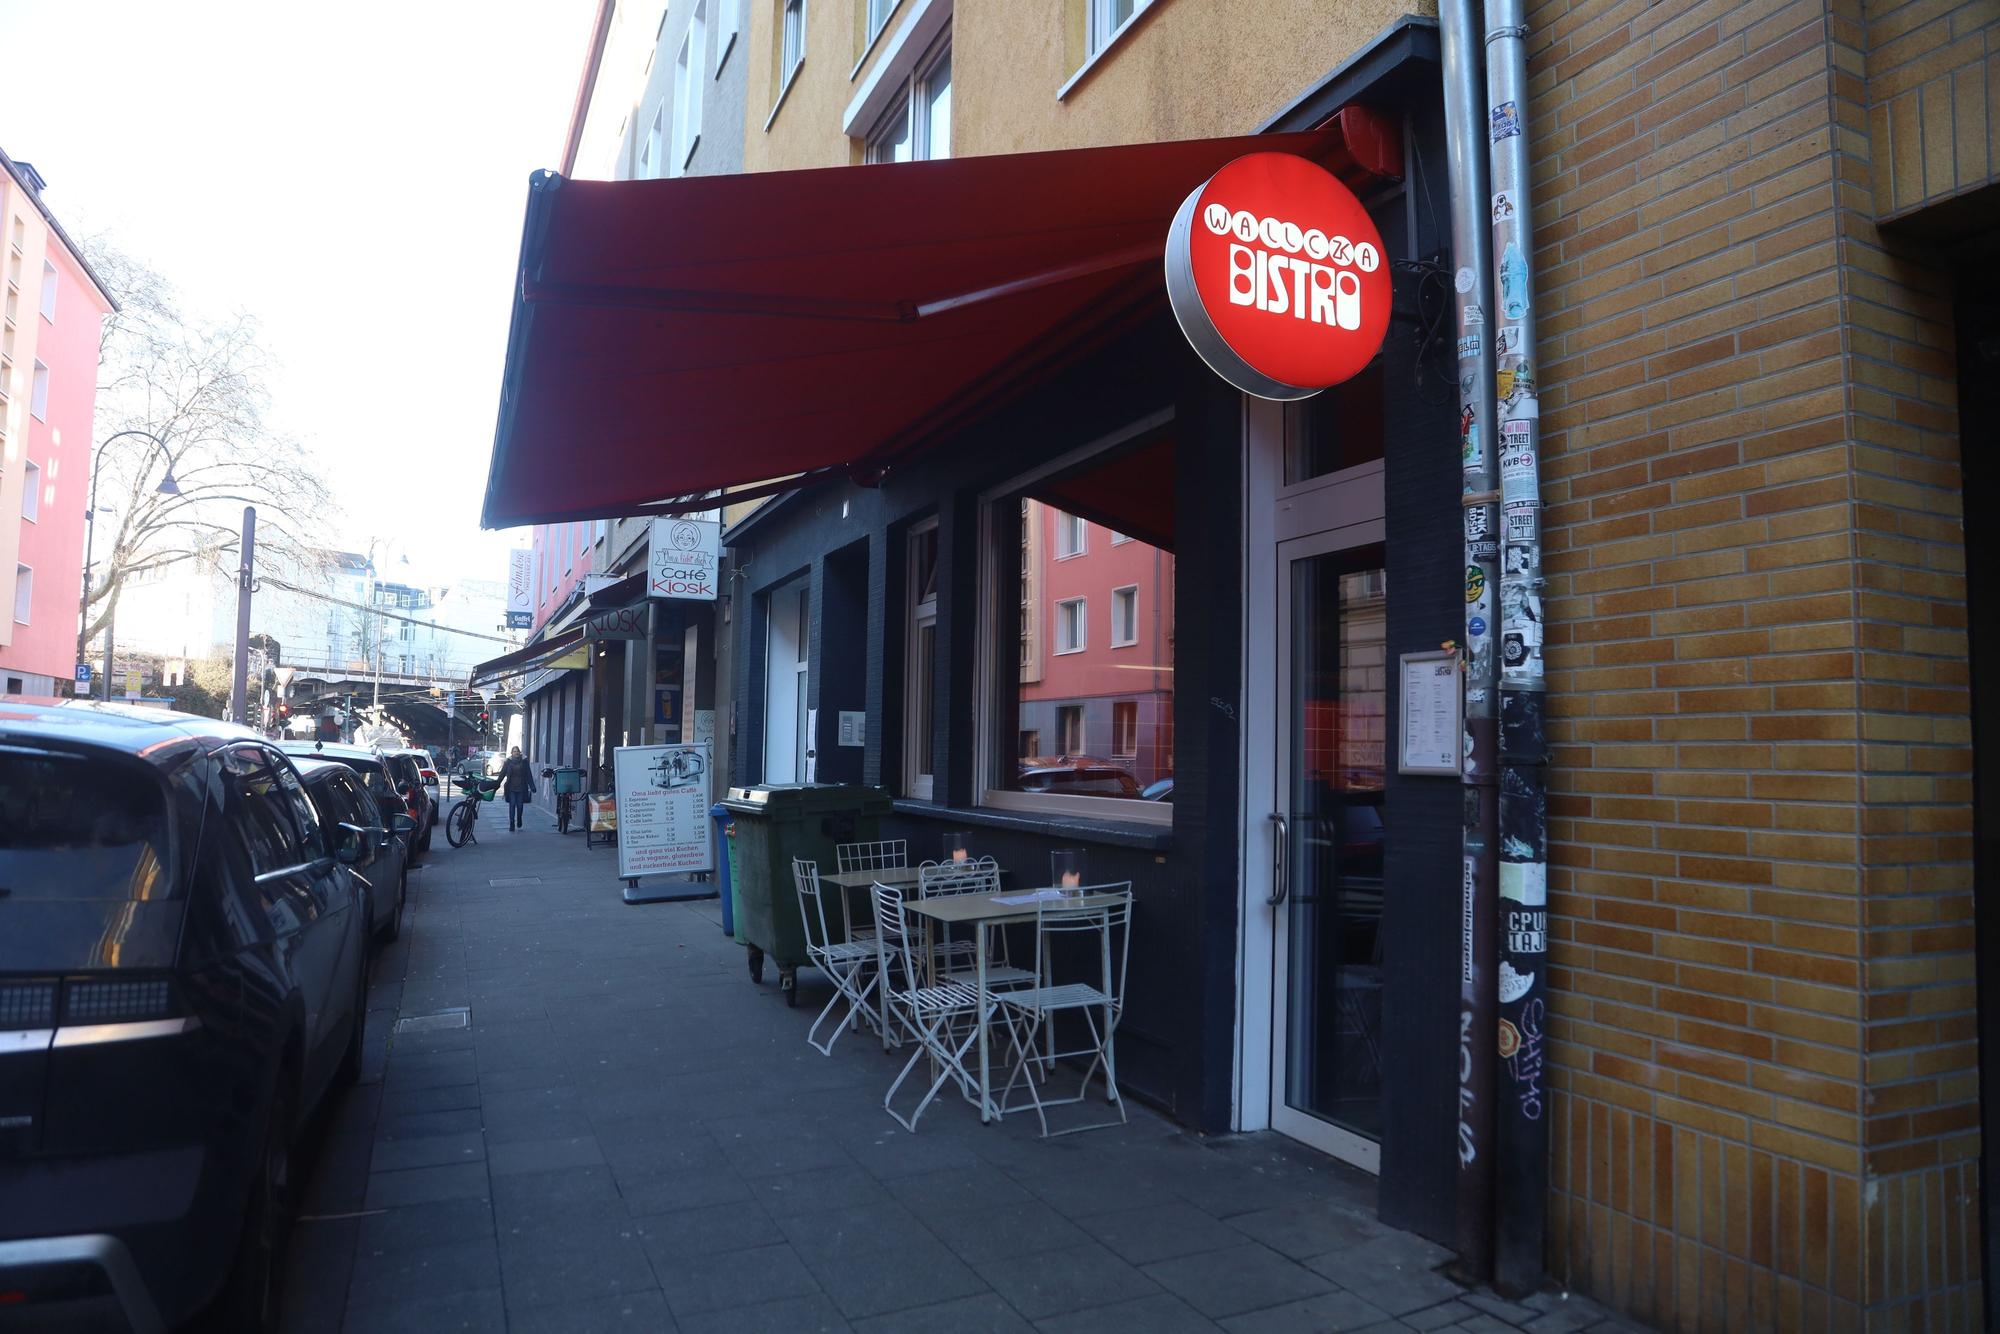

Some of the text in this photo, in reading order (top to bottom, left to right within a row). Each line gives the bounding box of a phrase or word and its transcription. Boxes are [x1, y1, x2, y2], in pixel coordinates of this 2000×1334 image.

[1229, 242, 1361, 331] BISTRO
[1509, 515, 1533, 526] STREET
[661, 567, 707, 581] Café
[77, 666, 87, 679] P
